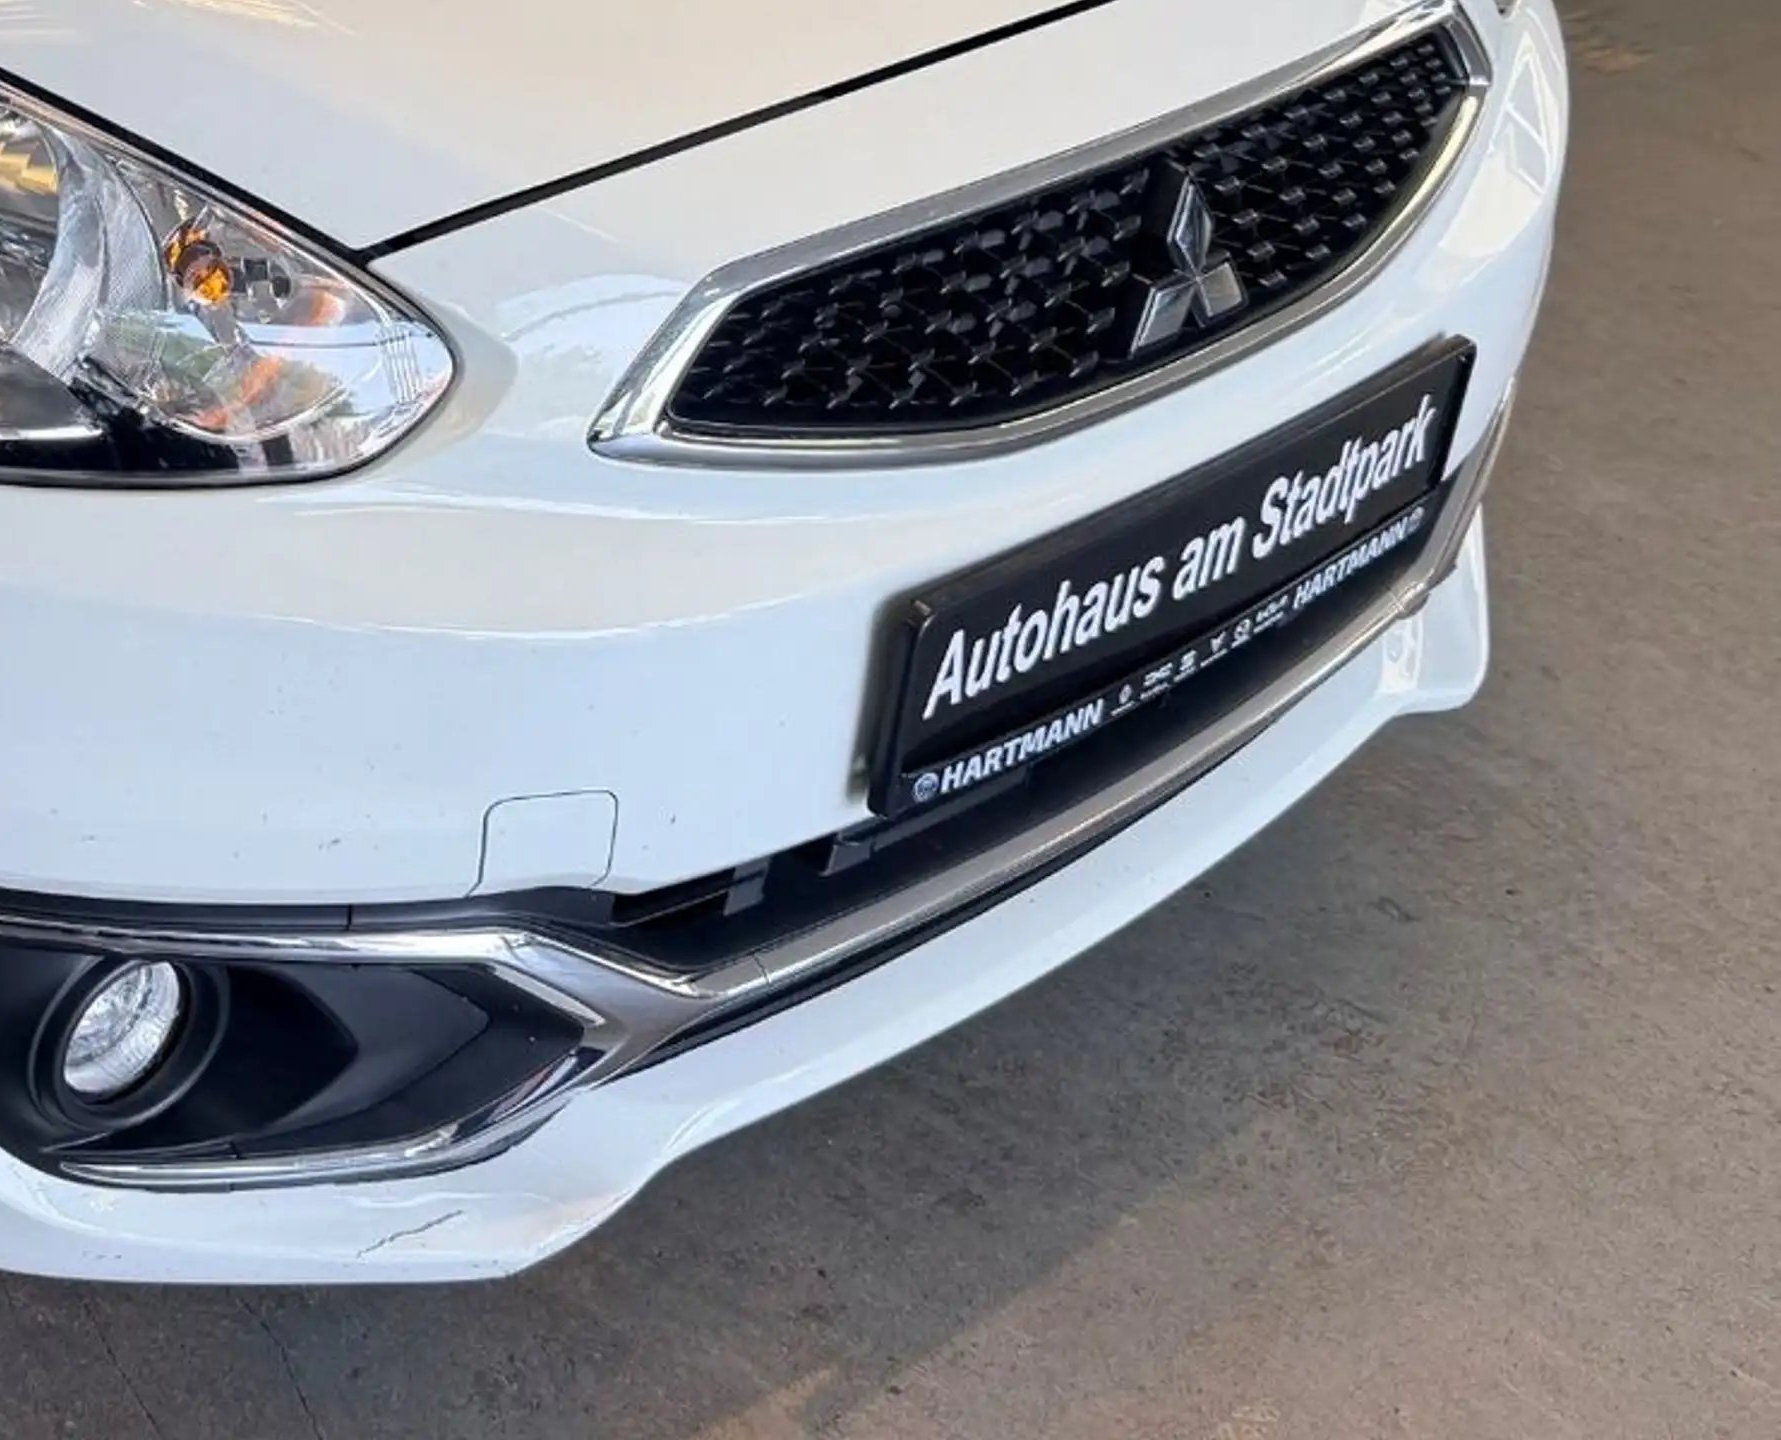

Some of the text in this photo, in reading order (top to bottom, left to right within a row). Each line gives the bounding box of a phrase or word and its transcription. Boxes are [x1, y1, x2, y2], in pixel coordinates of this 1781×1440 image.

[922, 556, 1165, 721] Autohaus
[1172, 516, 1246, 601] am
[1252, 393, 1437, 559] Stadtpark
[940, 515, 1409, 795] HARTMANN HARTMANN
